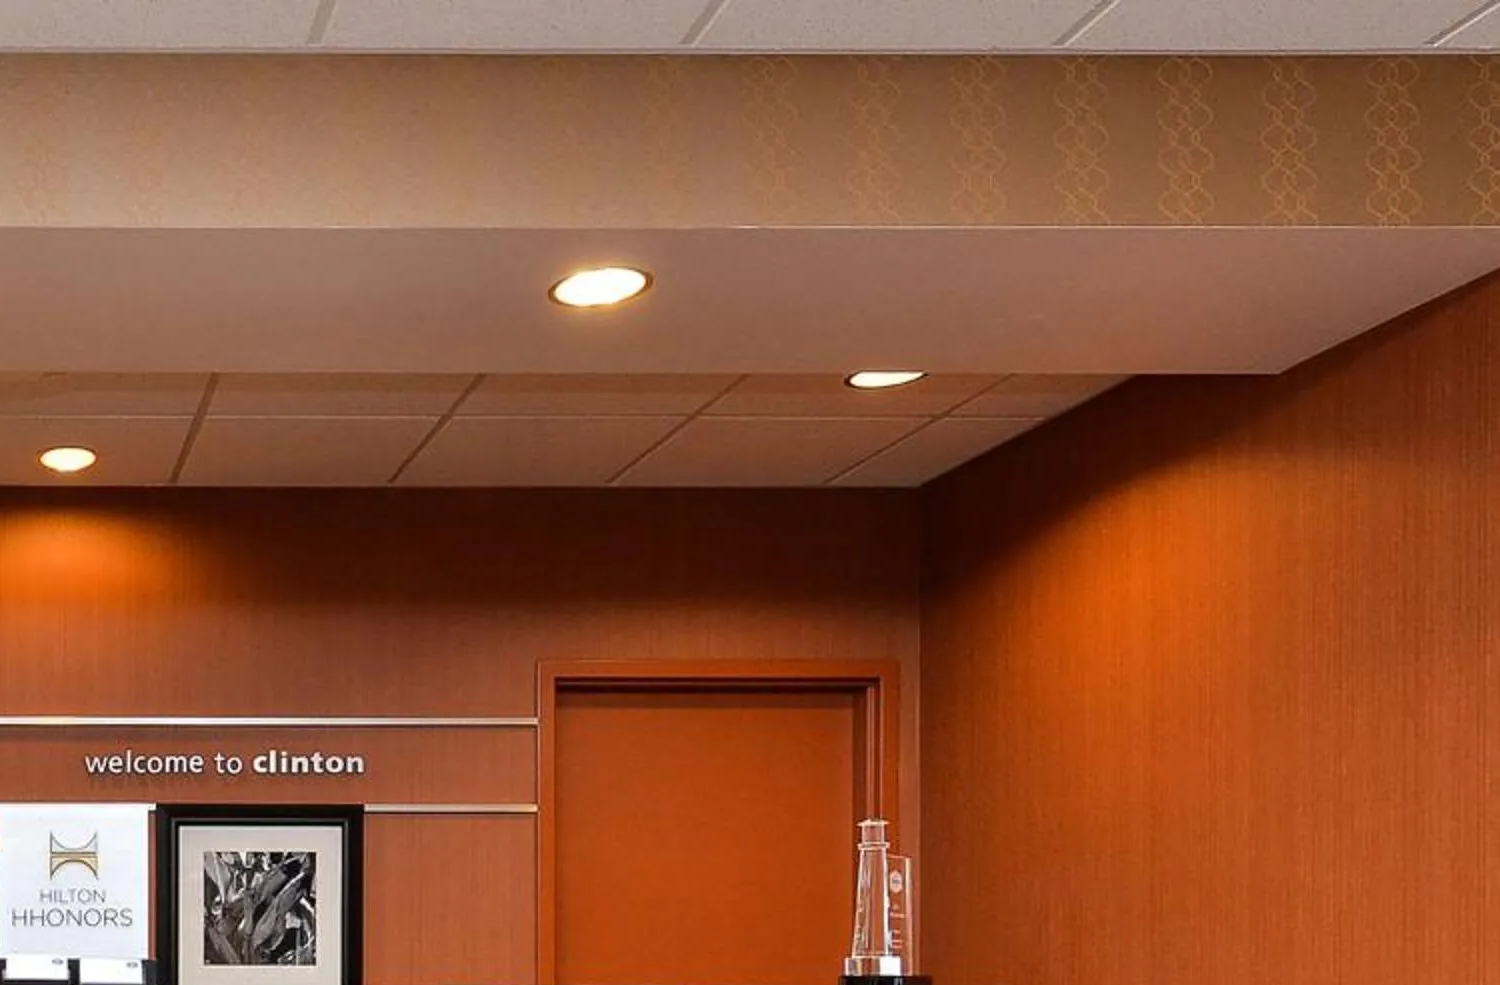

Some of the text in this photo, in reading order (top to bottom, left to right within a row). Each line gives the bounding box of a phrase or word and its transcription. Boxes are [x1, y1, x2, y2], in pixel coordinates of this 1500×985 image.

[84, 750, 364, 774] welcome to clinton
[39, 888, 106, 904] HILTON
[11, 907, 133, 927] HHONORS
